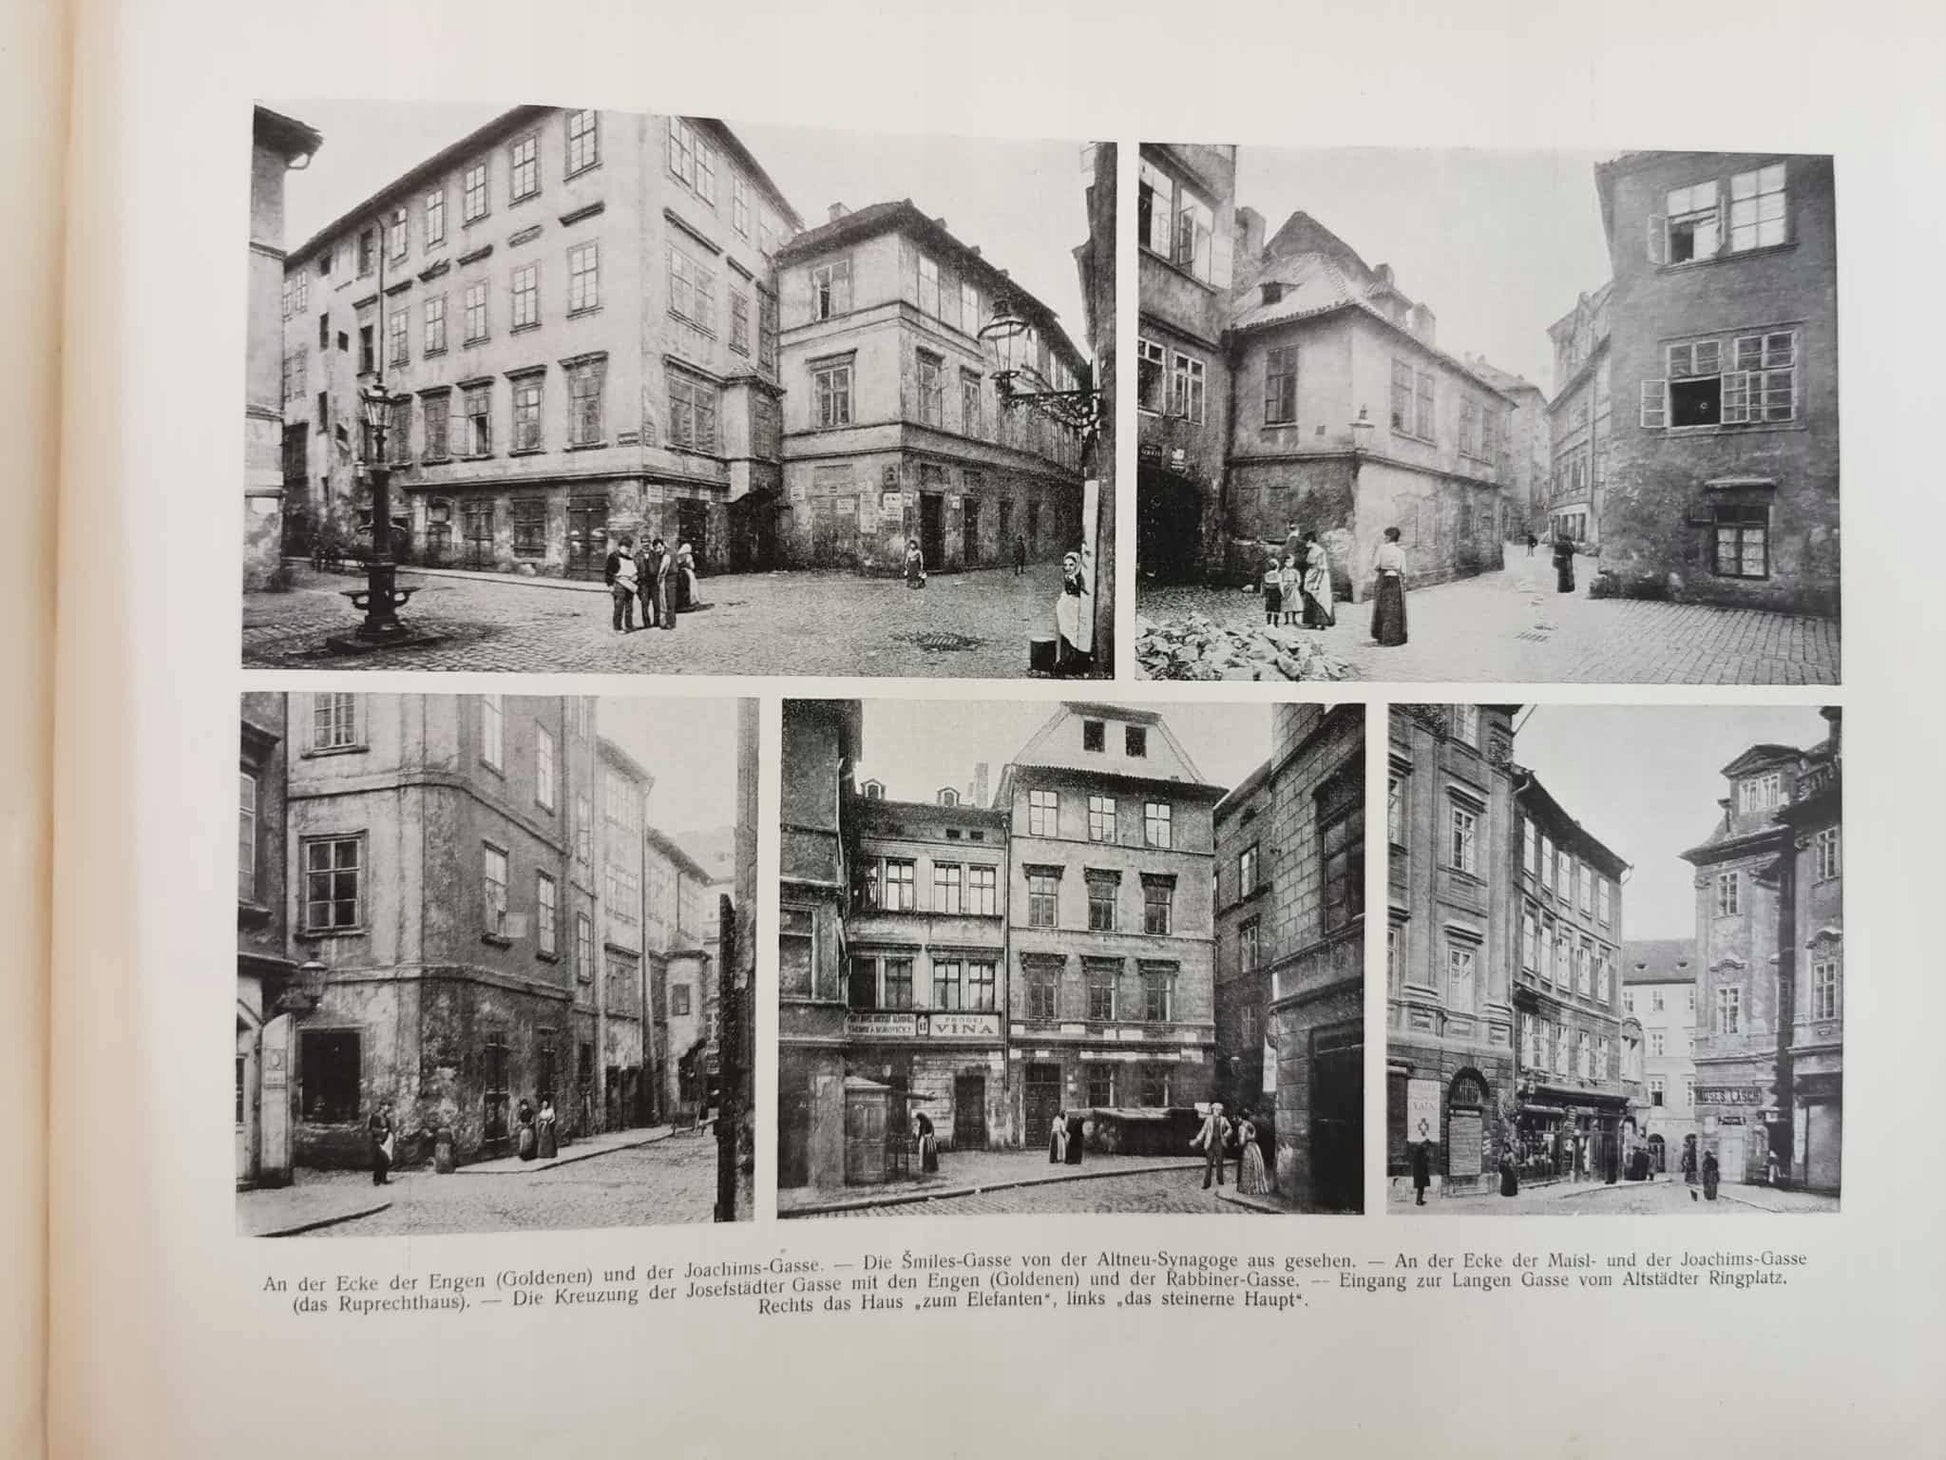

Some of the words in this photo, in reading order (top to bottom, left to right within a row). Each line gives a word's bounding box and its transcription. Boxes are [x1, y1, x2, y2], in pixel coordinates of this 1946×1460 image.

[262, 1275, 288, 1293] An
[297, 1276, 327, 1292] der
[336, 1275, 379, 1292] Ecke
[389, 1273, 419, 1291] der
[429, 1273, 485, 1294] Engen
[496, 1268, 593, 1291] (Goldenen)
[603, 1264, 636, 1283] und
[646, 1264, 675, 1281] der
[684, 1257, 824, 1279] Joachims-Gasse.
[863, 1254, 893, 1271] Die
[901, 1249, 1012, 1270] Šmiles-Gasse
[1021, 1255, 1051, 1268] von
[1060, 1251, 1088, 1268] der
[1097, 1250, 1238, 1271] Altneu-Synagoge
[1247, 1255, 1275, 1269] aus
[1284, 1252, 1357, 1274] gesehen.
[1394, 1252, 1418, 1269] An
[1427, 1253, 1455, 1269] der
[1463, 1252, 1503, 1269] Ecke
[1512, 1252, 1539, 1268] der
[1547, 1252, 1597, 1268] Maisl-
[1607, 1252, 1637, 1268] und
[1645, 1252, 1673, 1267] der
[1680, 1250, 1808, 1267] Joachims-Gasse
[292, 1295, 328, 1316] (das
[338, 1293, 471, 1316] Ruprechthaus).
[512, 1289, 544, 1307] Die
[554, 1287, 639, 1308] Kreuzung
[648, 1284, 677, 1300] der
[686, 1278, 785, 1299] Josefstädter
[792, 1276, 842, 1293] Gasse
[851, 1274, 878, 1291] mit
[887, 1273, 918, 1290] den
[927, 1272, 980, 1293] Engen
[989, 1270, 1080, 1290] (Goldenen)
[1090, 1269, 1120, 1287] und
[1129, 1269, 1157, 1286] der
[1166, 1270, 1300, 1288] Rabbiner-Gasse.
[1339, 1271, 1407, 1293] Eingang
[1416, 1276, 1443, 1289] zur
[1452, 1271, 1512, 1292] Langen
[1520, 1271, 1570, 1288] Gasse
[1578, 1275, 1613, 1287] vom
[1622, 1270, 1700, 1287] Altstädter
[1709, 1269, 1788, 1290] Ringplatz.
[758, 1296, 814, 1316] Rechts
[823, 1294, 852, 1312] das
[861, 1293, 904, 1311] Haus
[1066, 1289, 1106, 1307] links
[1161, 1290, 1235, 1307] steinerne
